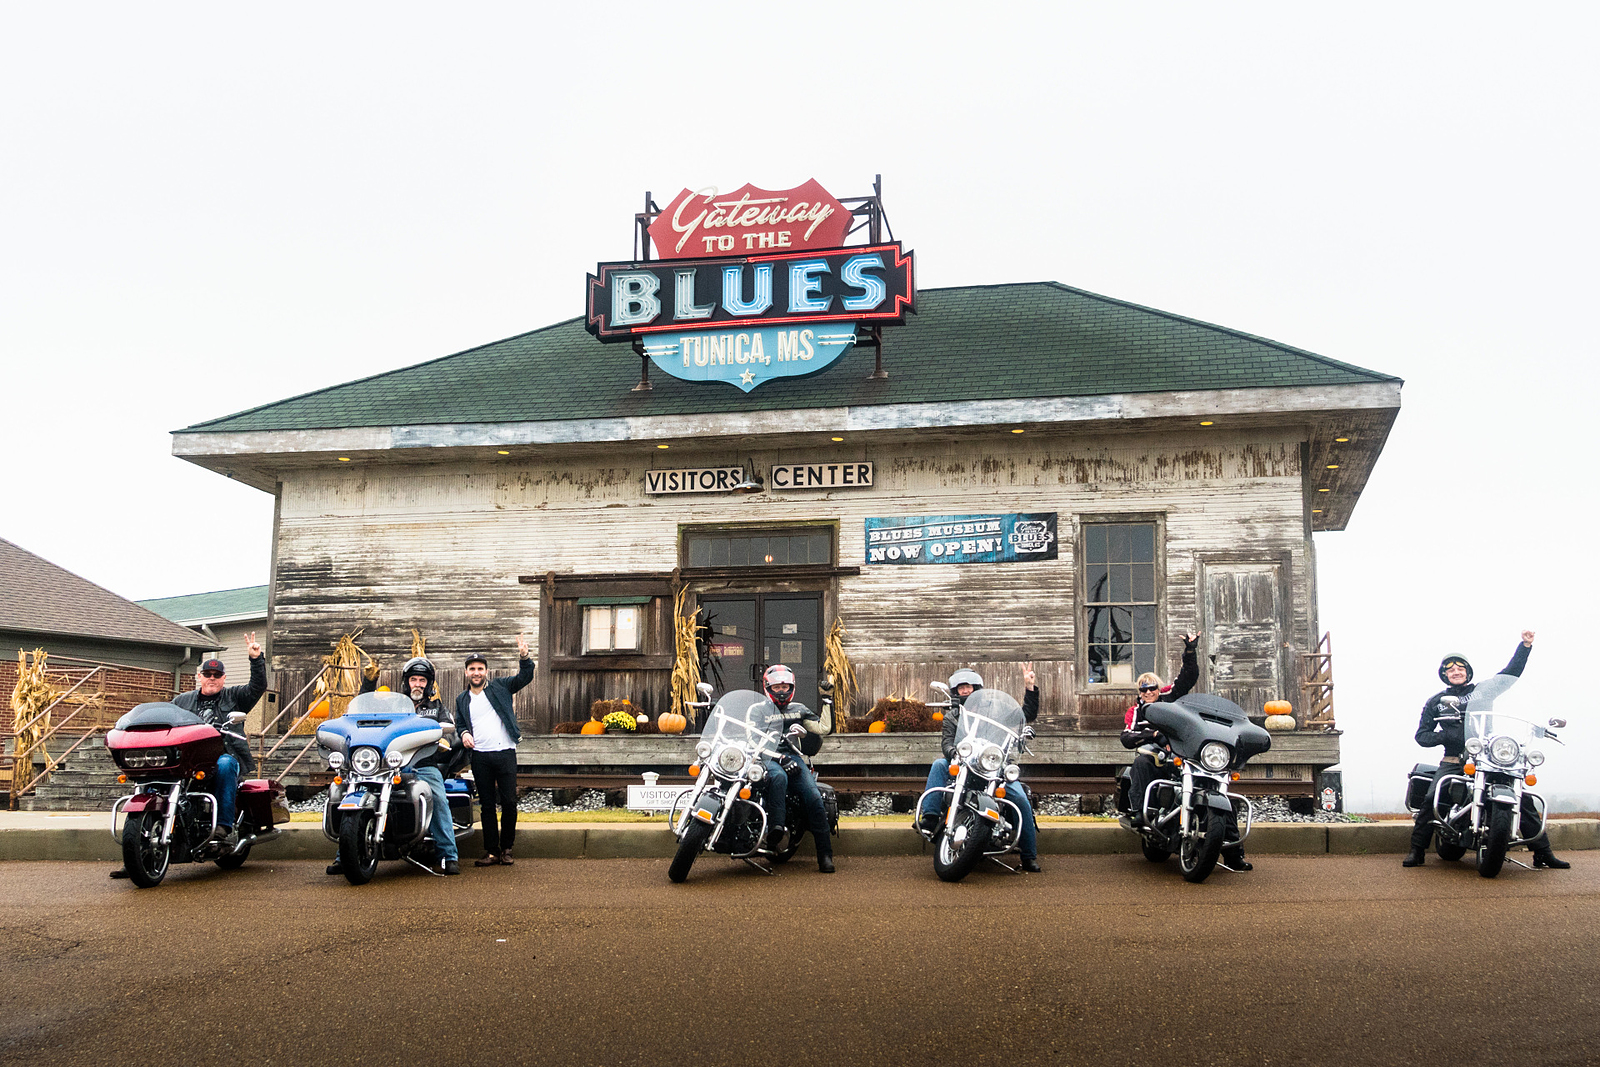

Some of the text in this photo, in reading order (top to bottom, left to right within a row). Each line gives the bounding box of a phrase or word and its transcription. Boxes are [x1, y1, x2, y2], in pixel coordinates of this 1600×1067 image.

[672, 186, 834, 253] Gateway
[702, 231, 792, 253] TO THE
[610, 253, 887, 327] BLUES
[680, 329, 814, 367] TUNICA, MS
[648, 465, 870, 491] VISITORS CENTER
[869, 521, 1001, 541] BLUES MUSEUM
[1011, 532, 1050, 543] BLUES
[869, 538, 1002, 562] NOW OPEN!
[640, 790, 677, 799] VISITOR
